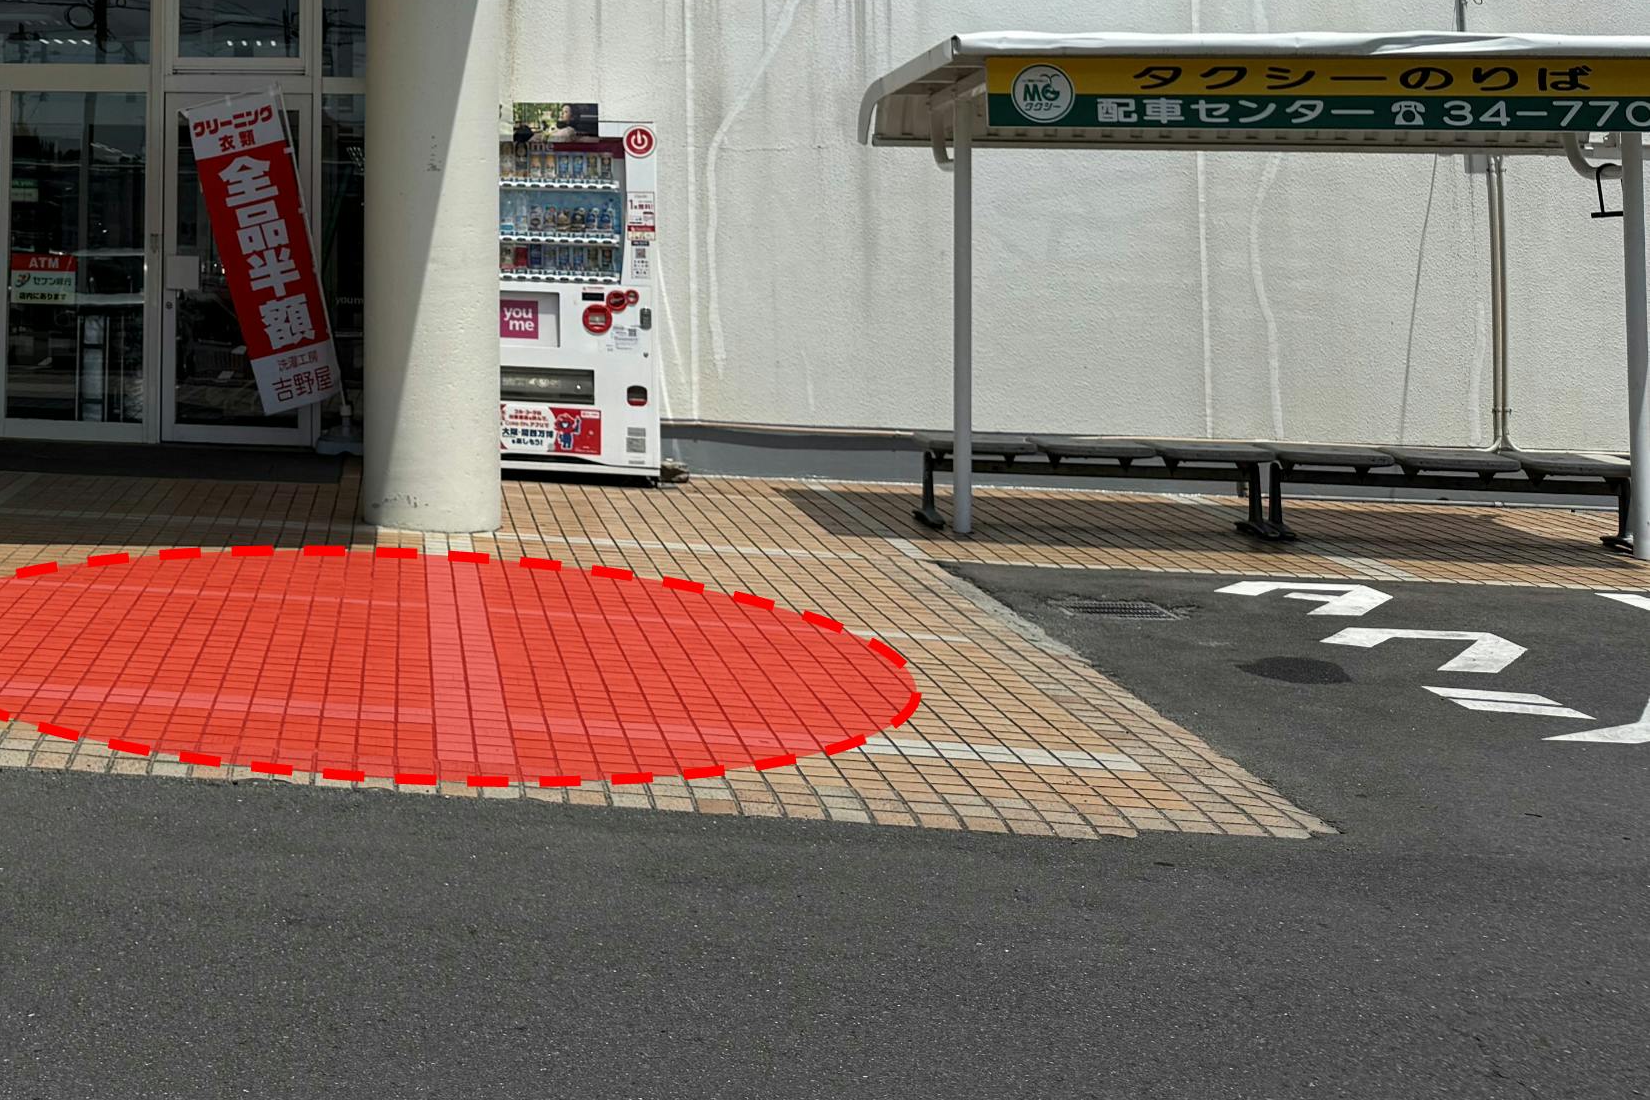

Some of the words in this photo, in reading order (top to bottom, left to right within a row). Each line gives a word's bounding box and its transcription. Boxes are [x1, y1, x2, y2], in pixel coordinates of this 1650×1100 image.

[1134, 65, 1592, 91] タクシーのりば
[193, 105, 273, 137] クリーニング
[1098, 98, 1375, 124] 配車センター
[219, 132, 255, 151] 衣類
[218, 155, 315, 349] 全品半額
[29, 257, 59, 268] ATM
[34, 277, 71, 285] セブン銀行
[19, 292, 66, 300] 店内にあります
[504, 307, 532, 320] you
[509, 321, 534, 331] me
[278, 350, 318, 371] 洗濯工房
[273, 366, 333, 401] 吉野屋
